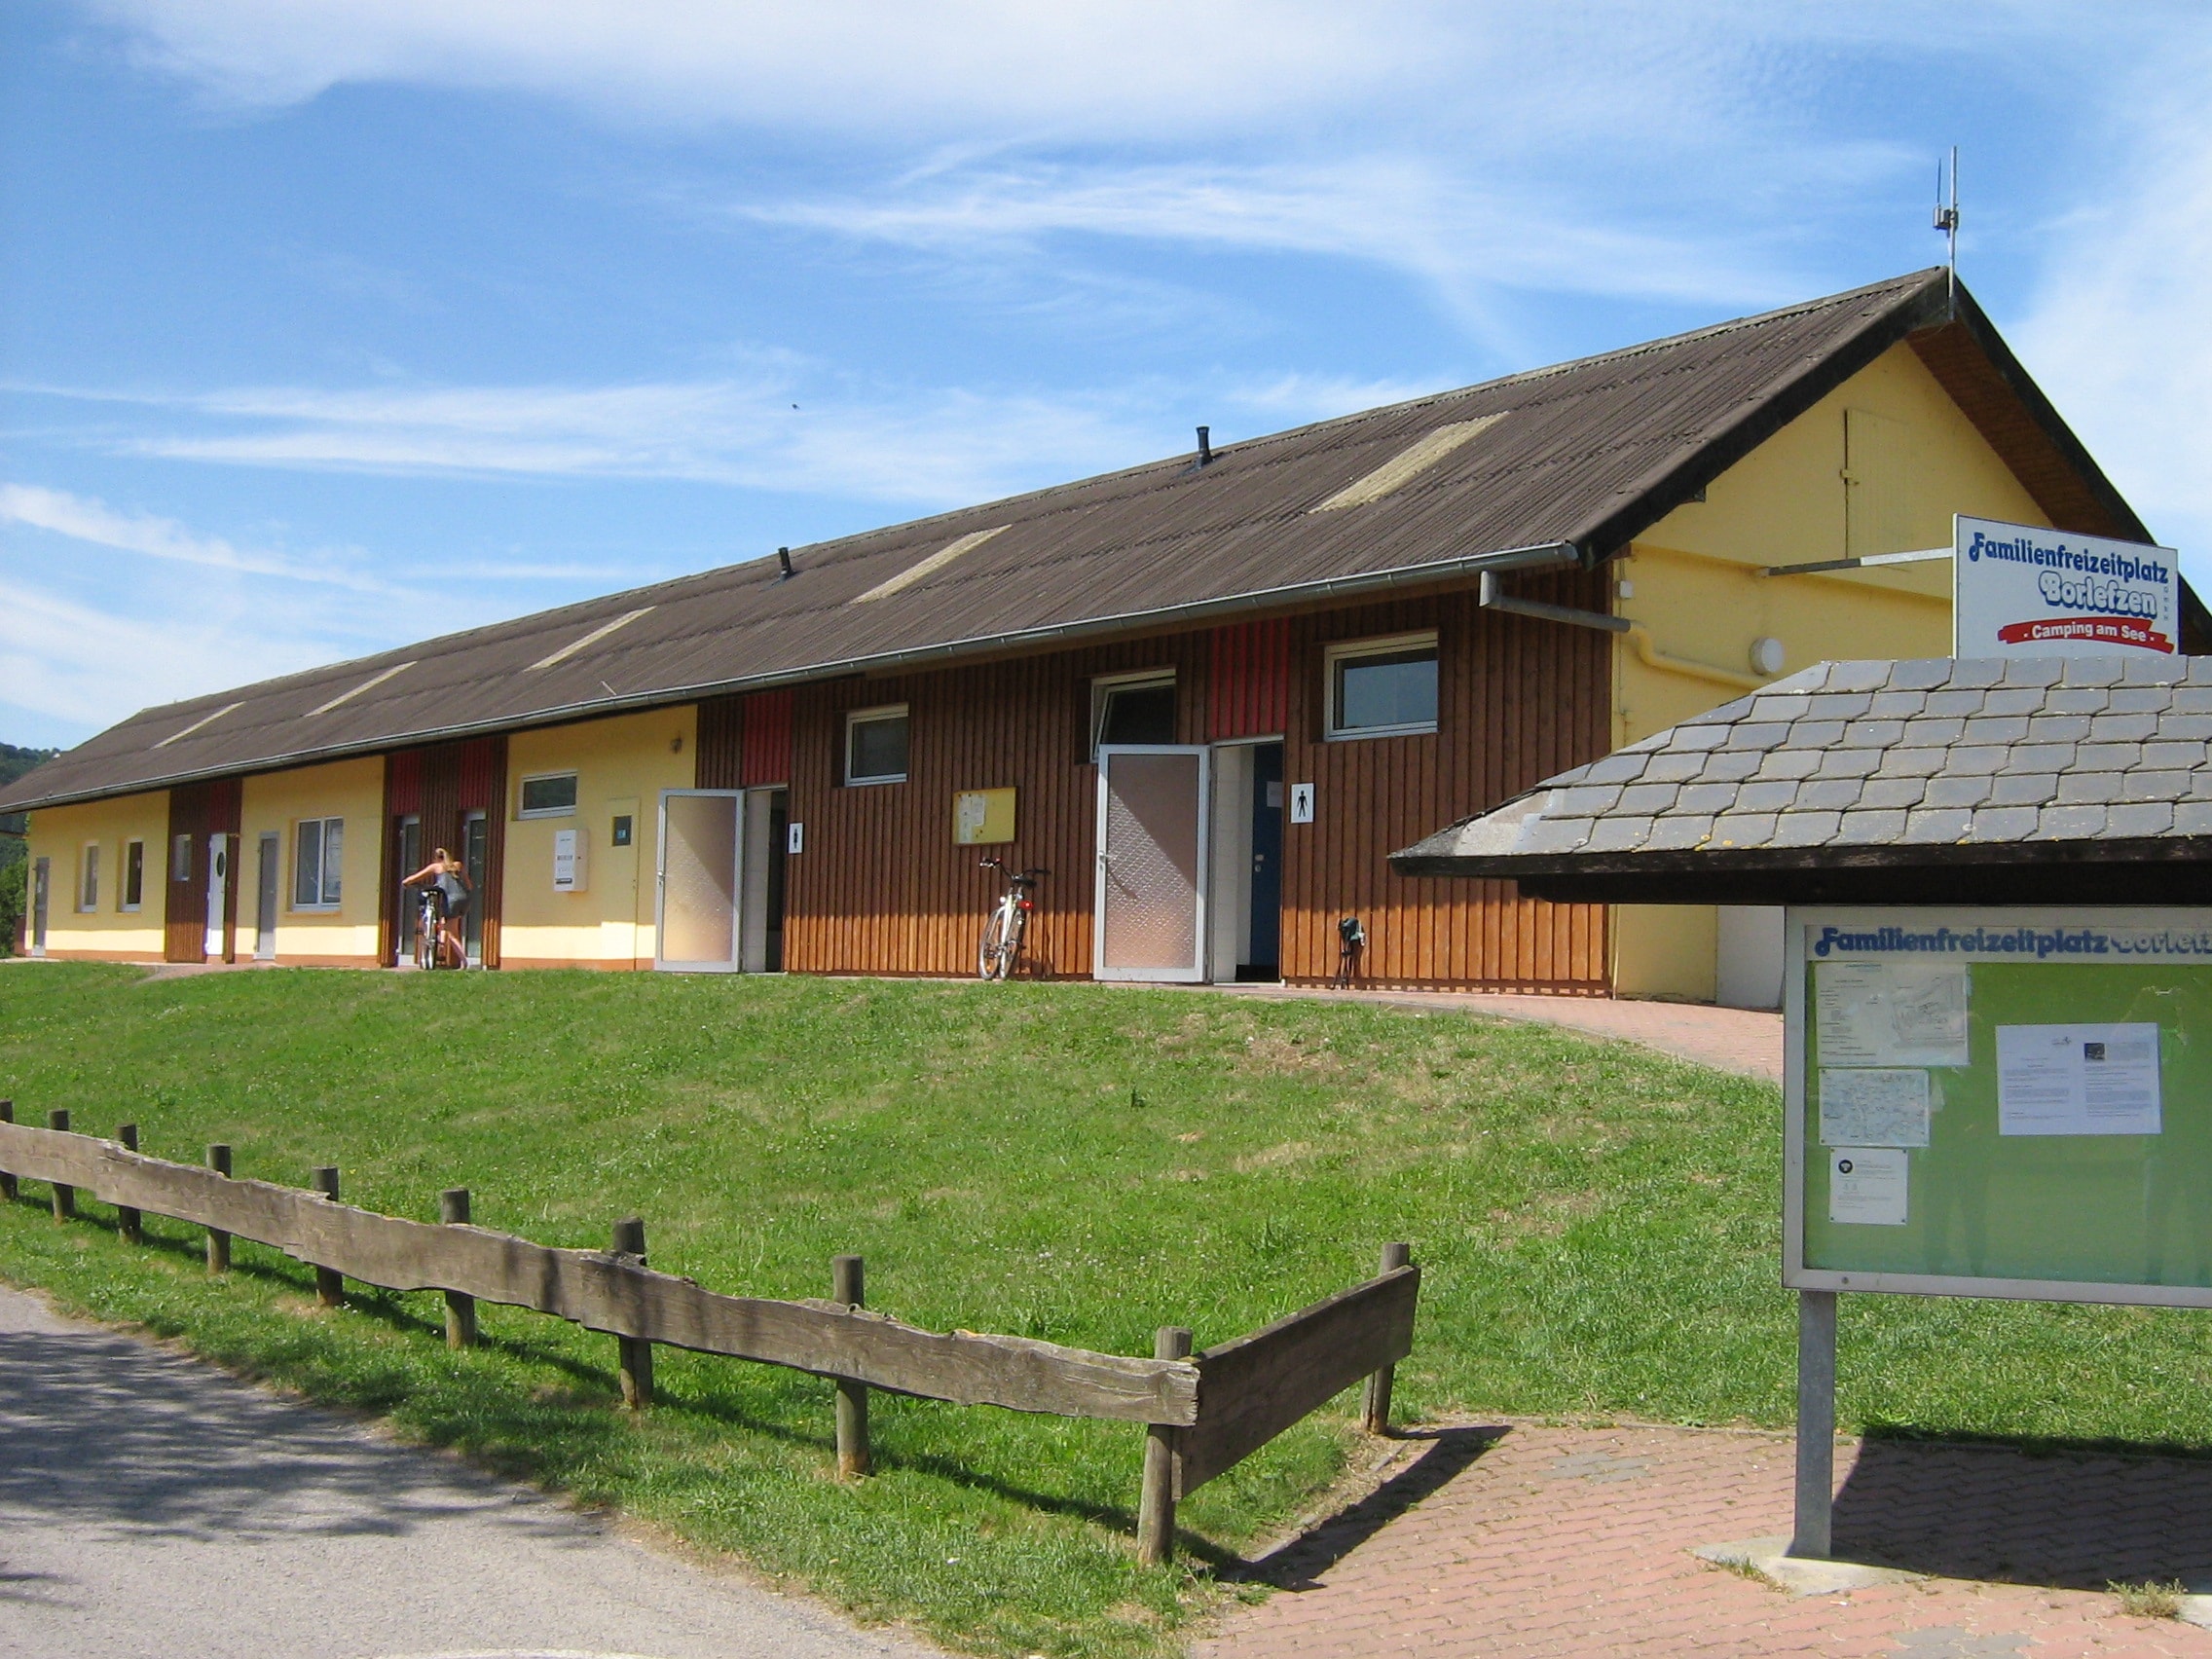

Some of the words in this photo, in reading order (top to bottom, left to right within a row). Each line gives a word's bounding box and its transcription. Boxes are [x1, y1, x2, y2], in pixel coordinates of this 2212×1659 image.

[1969, 532, 2168, 584] Familienfreizeitplatz
[2039, 571, 2157, 619] Borlefzen
[2032, 621, 2093, 639] Camping
[2096, 624, 2118, 637] am
[2120, 625, 2147, 642] See
[1815, 927, 2109, 959] Familienfreizeitplatz
